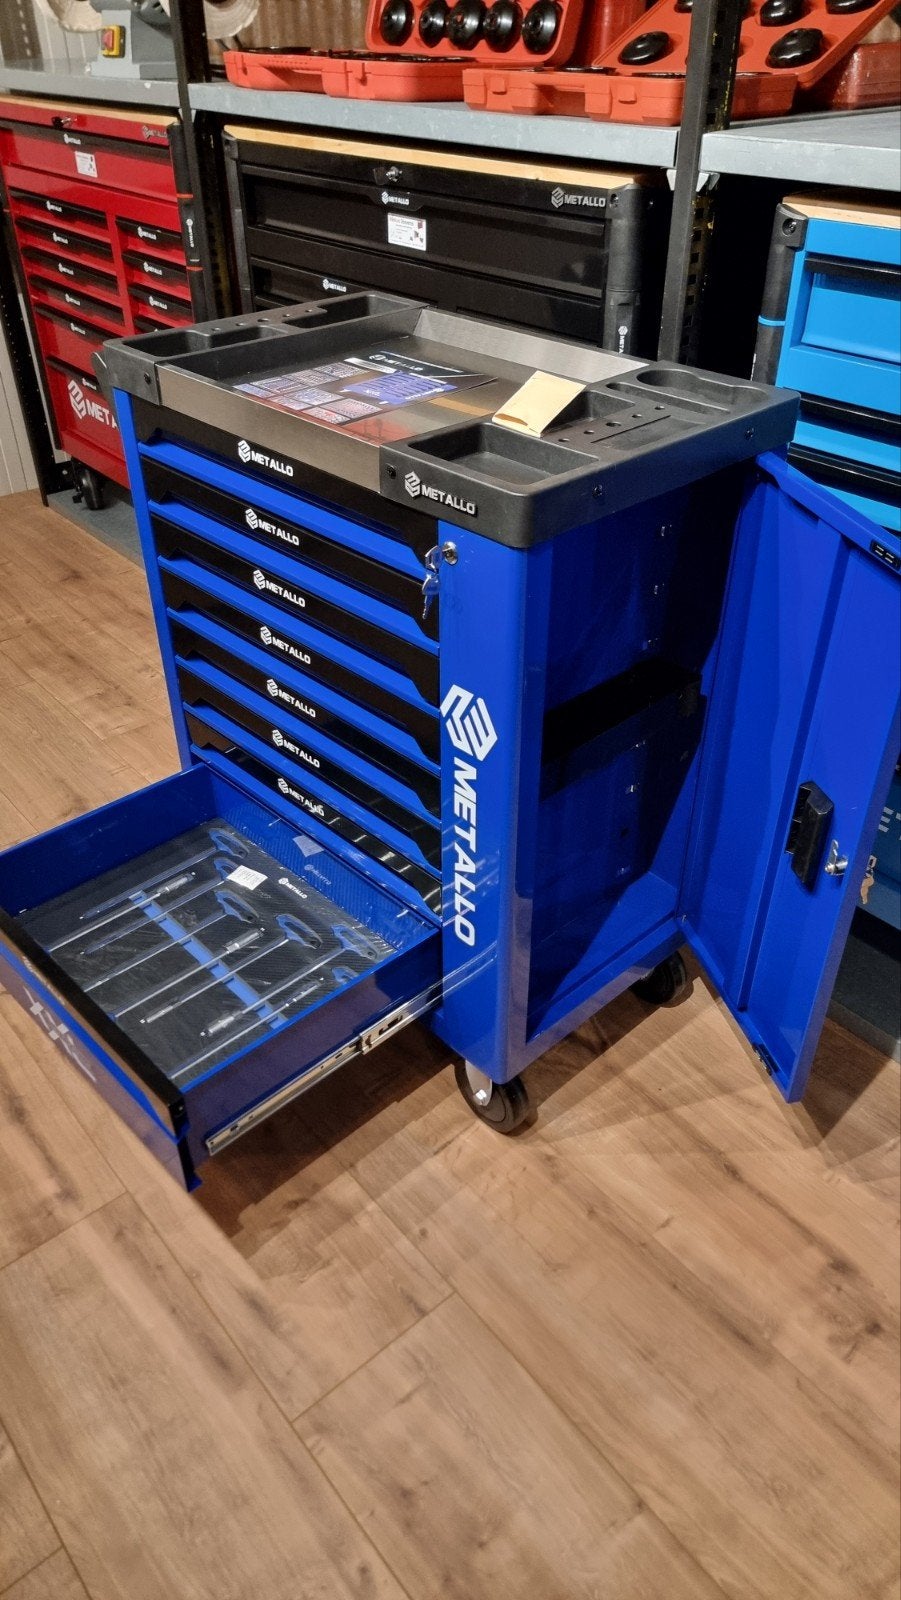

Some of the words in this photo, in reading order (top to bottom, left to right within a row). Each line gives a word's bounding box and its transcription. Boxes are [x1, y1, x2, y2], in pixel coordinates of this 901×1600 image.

[564, 194, 606, 208] METALLO
[250, 450, 294, 477] METALLO
[421, 484, 476, 516] METALLO
[258, 519, 300, 546] METALLO
[265, 579, 306, 608] METALLO
[272, 636, 312, 665] METALLO
[278, 689, 316, 718] METALLO
[283, 739, 321, 769] METALLO
[288, 787, 325, 817] METALLO
[454, 756, 477, 947] METALLO
